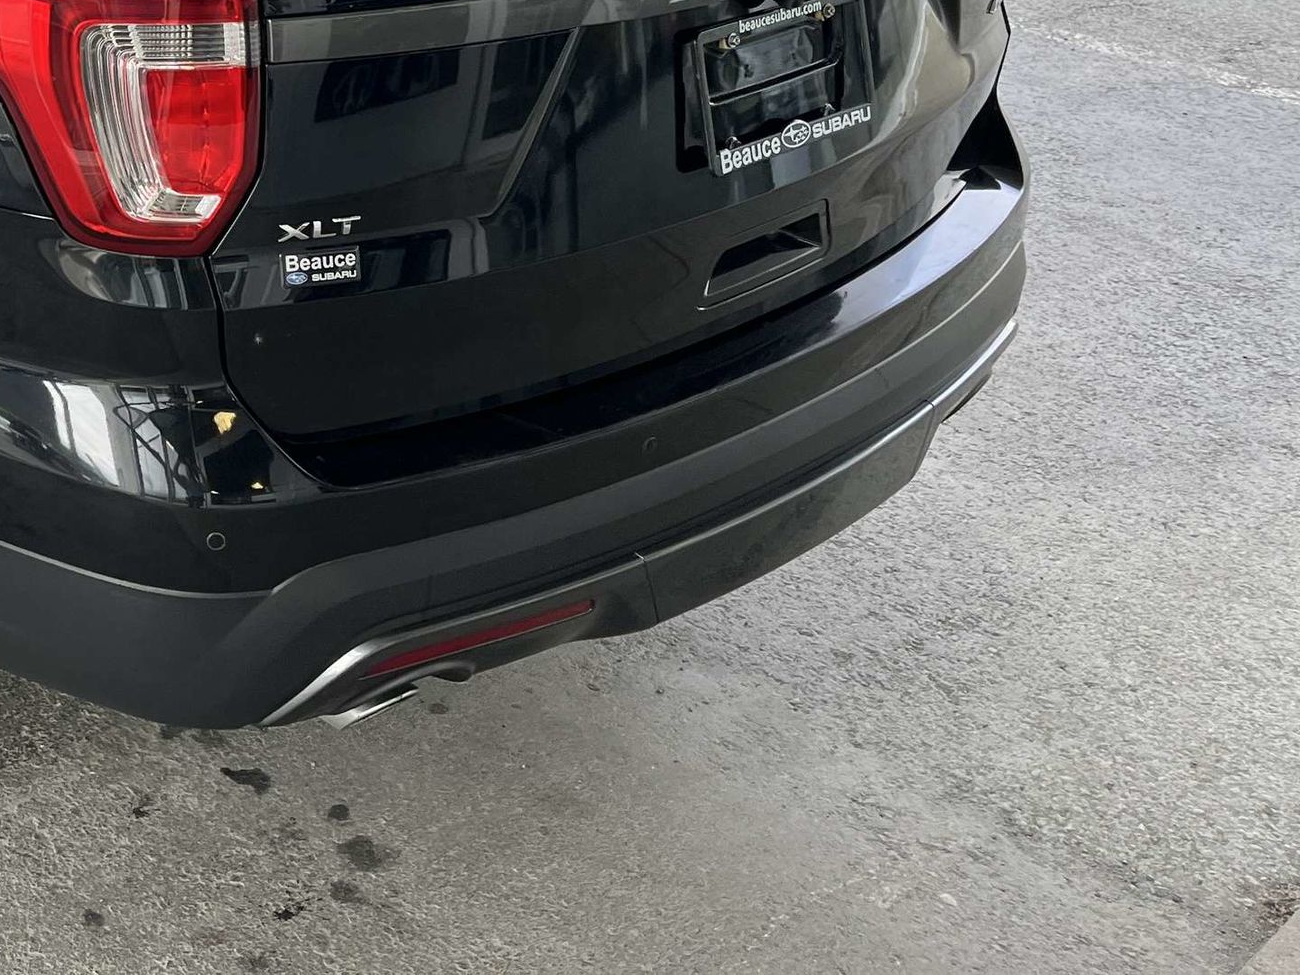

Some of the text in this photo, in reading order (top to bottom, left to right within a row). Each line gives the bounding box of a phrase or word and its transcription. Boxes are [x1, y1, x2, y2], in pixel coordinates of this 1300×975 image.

[738, 0, 822, 34] beaucesubaru.com
[720, 106, 871, 175] Beauce SUBARU
[277, 215, 361, 243] XLT
[285, 252, 356, 272] Beauce
[312, 270, 357, 282] SUBARU
